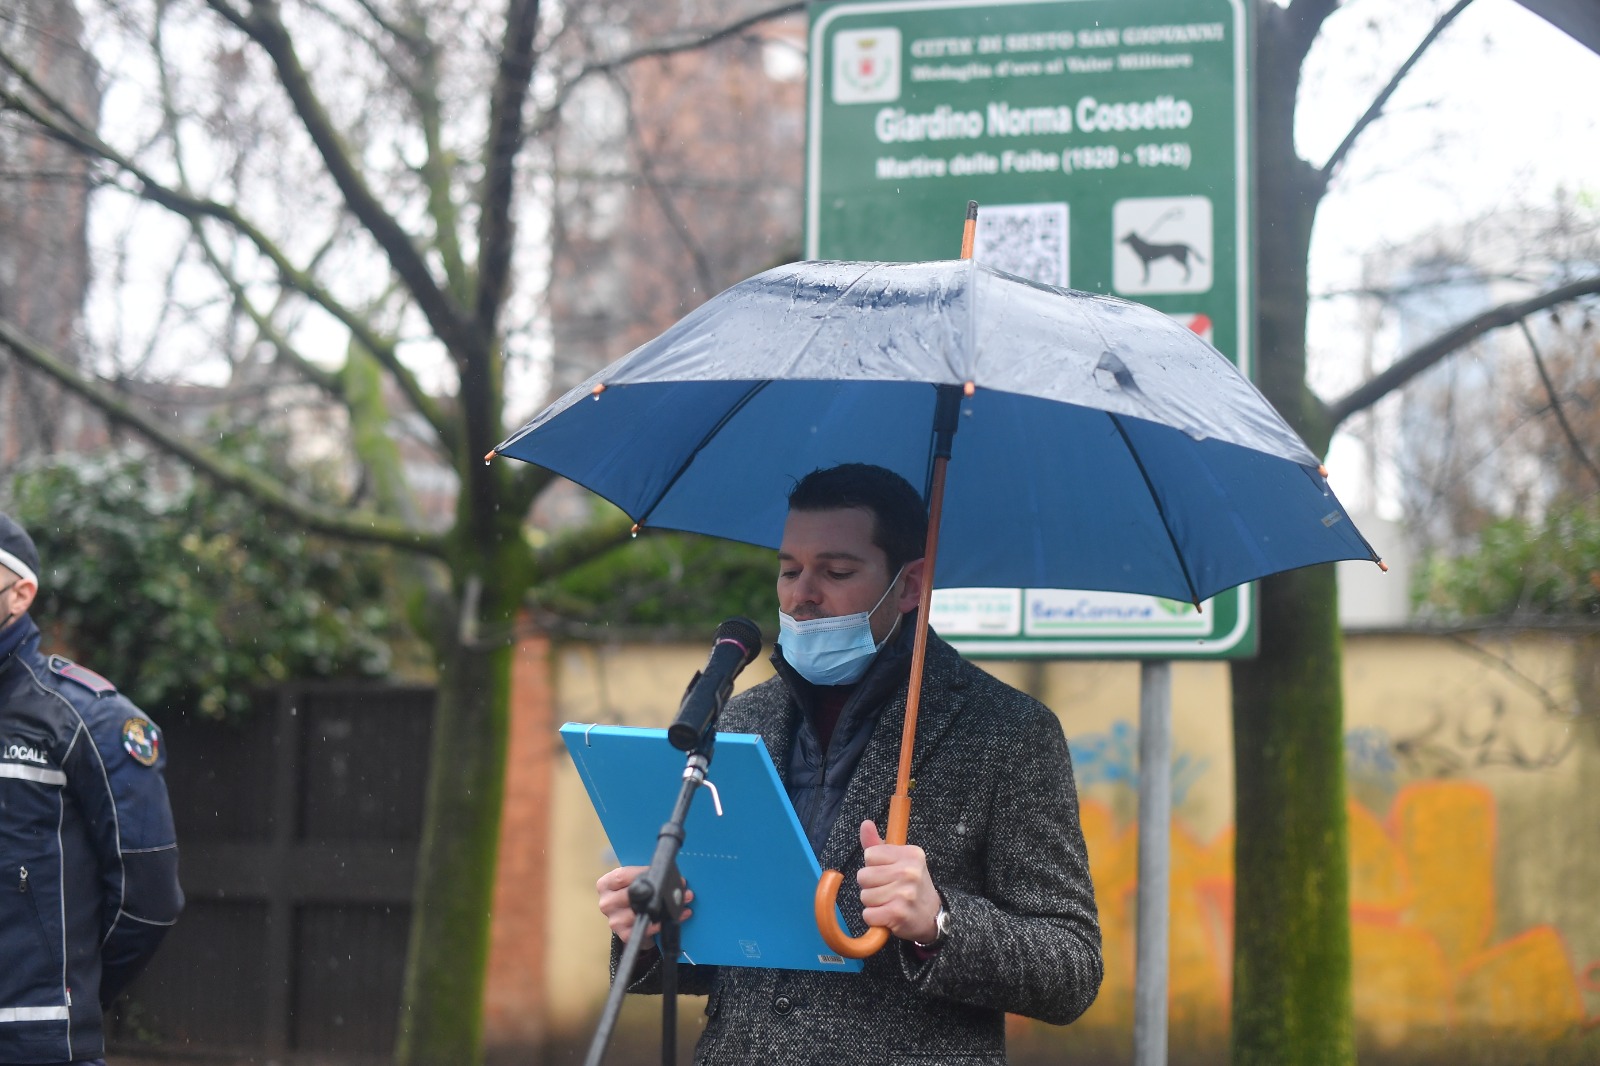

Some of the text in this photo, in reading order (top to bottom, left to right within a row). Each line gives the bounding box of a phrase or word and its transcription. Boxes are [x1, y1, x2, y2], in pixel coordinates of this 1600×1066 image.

[977, 34, 1003, 53] DI
[1004, 31, 1075, 52] SESTO
[1077, 29, 1120, 48] SAN
[1122, 24, 1224, 45] GIOVANNI
[910, 64, 993, 82] Medaglia
[1044, 57, 1064, 73] al
[1066, 57, 1113, 72] Valor
[1117, 54, 1193, 70] Militare
[876, 96, 1192, 142] Giardino Norma Cossetto
[876, 157, 947, 178] Martire
[949, 153, 1000, 175] delle
[1001, 150, 1060, 172] Foibe
[1135, 143, 1192, 169] 1943)
[1032, 601, 1153, 619] BeneComune
[3, 744, 48, 764] LOCALE
